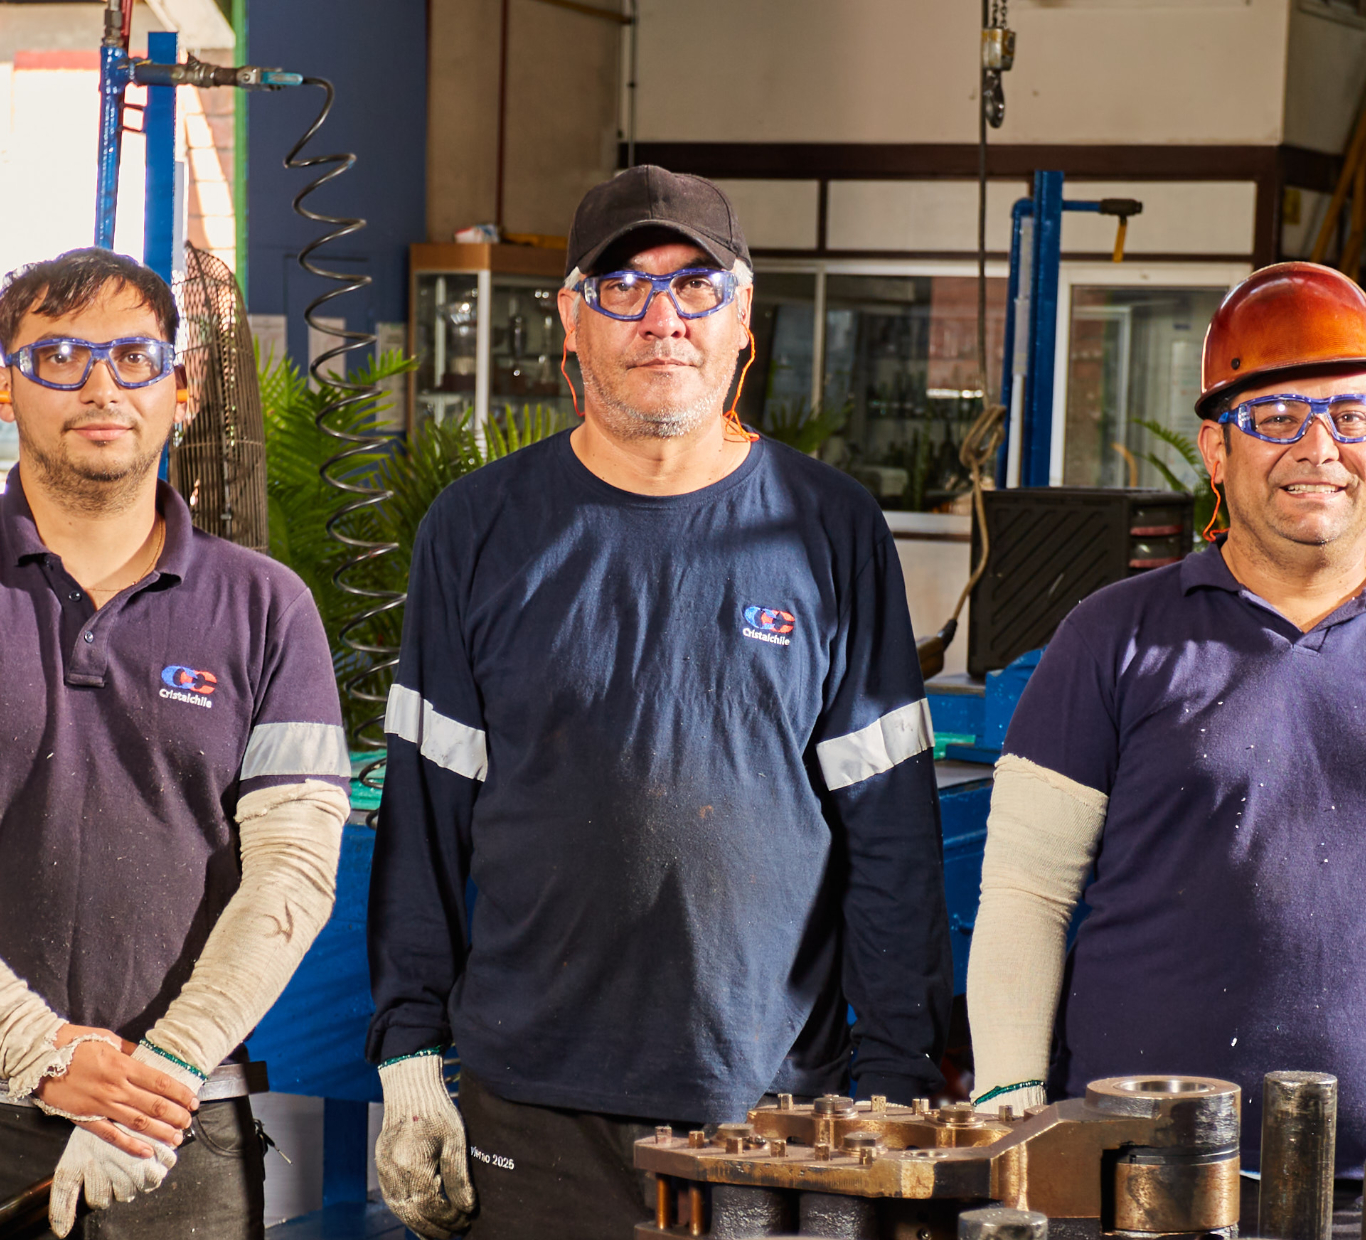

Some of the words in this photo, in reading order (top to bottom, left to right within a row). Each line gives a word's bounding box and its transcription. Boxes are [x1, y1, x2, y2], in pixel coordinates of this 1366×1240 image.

[742, 627, 790, 646] Cristalchile
[159, 688, 212, 709] Cristalchile
[492, 1153, 515, 1170] 2025
